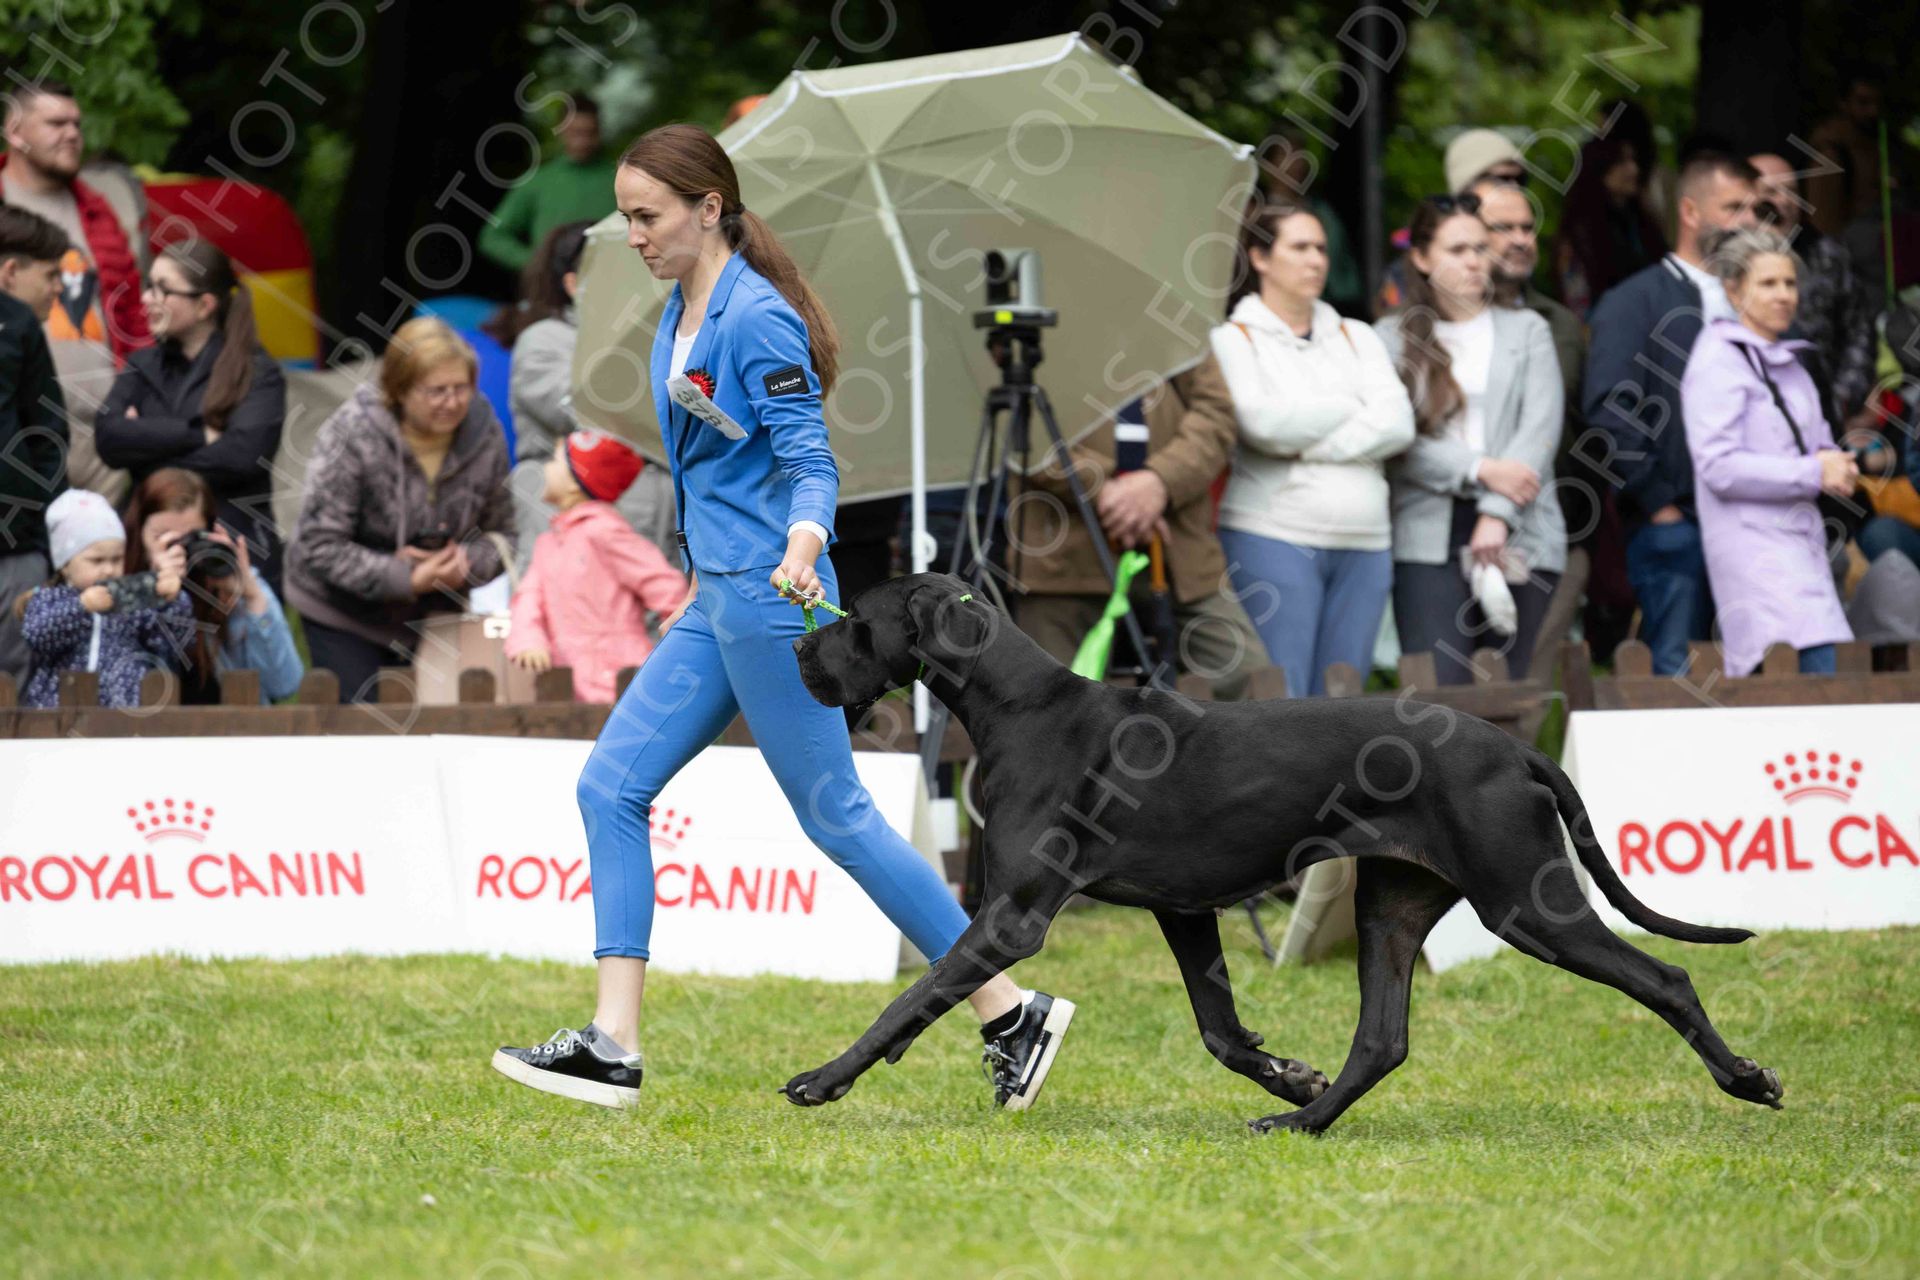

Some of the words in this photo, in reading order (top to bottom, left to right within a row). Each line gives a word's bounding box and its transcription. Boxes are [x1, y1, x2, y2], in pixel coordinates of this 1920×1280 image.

[676, 390, 723, 427] 378
[1617, 815, 1814, 877] ROYAL
[0, 853, 175, 902] ROYAL
[187, 851, 366, 899] CANIN
[476, 853, 593, 902] ROY
[653, 863, 818, 914] CANIN
